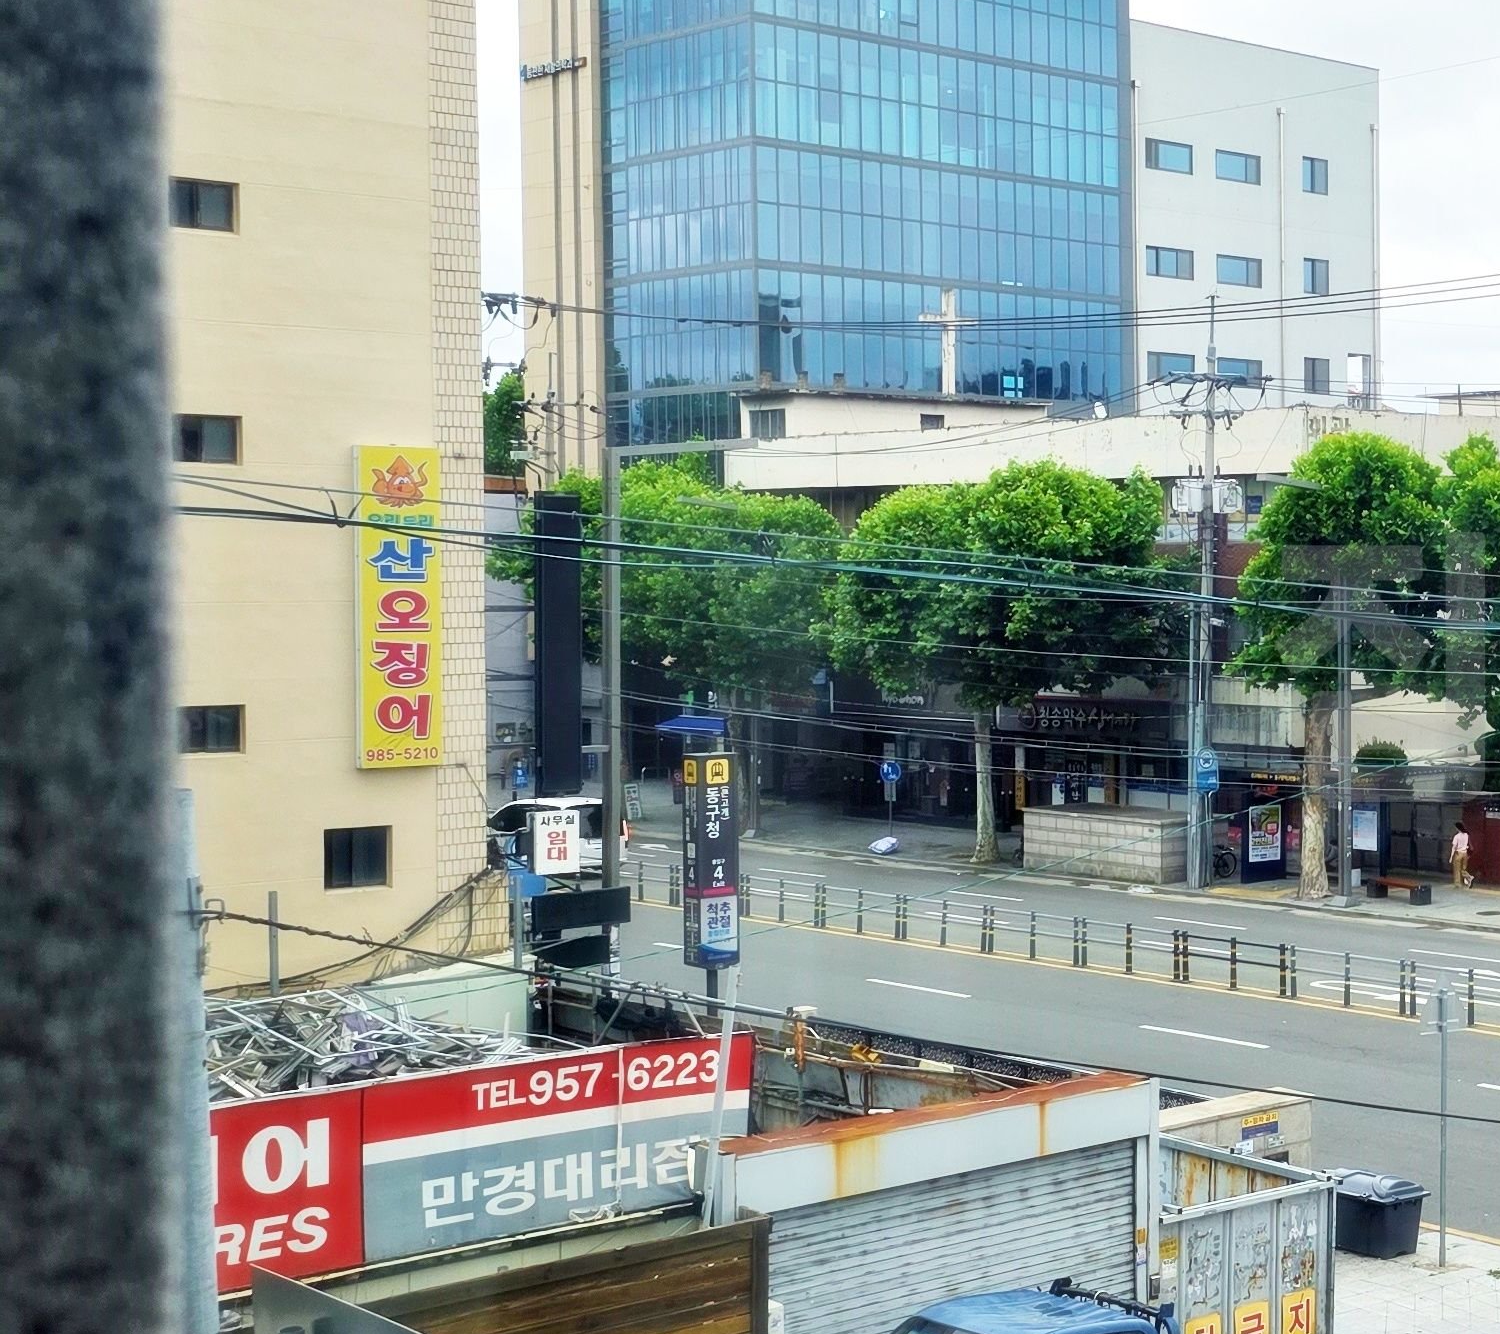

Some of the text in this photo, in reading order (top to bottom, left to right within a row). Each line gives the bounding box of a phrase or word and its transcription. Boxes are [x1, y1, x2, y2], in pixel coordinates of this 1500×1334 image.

[368, 537, 435, 738] 산오징어
[366, 747, 438, 761] 985-5210
[540, 814, 575, 826] 사무실
[706, 787, 720, 839] 동구청
[547, 830, 568, 861] 임대
[713, 865, 724, 880] 4
[214, 1206, 330, 1266] RES
